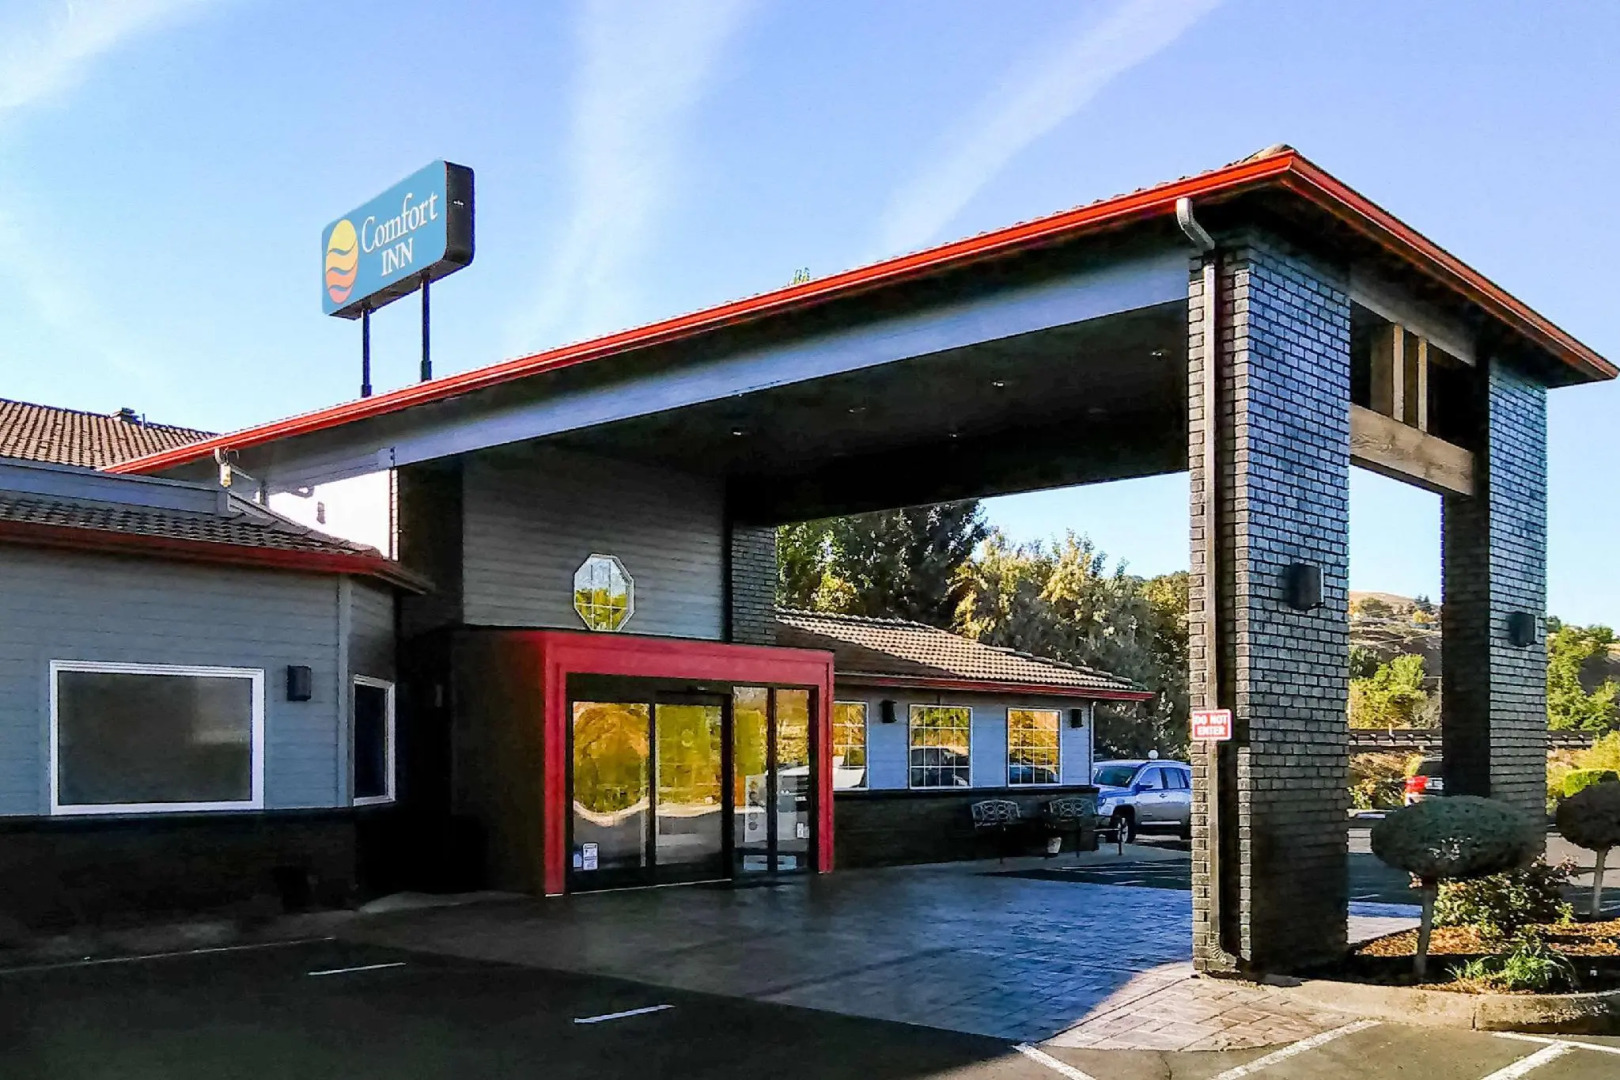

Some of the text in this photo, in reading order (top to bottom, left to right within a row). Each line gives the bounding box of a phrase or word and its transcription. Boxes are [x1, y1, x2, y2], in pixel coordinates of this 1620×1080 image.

[361, 191, 438, 253] Comfort
[381, 238, 413, 276] INN
[1193, 713, 1228, 725] DO NOT
[1197, 726, 1225, 736] ENTER
